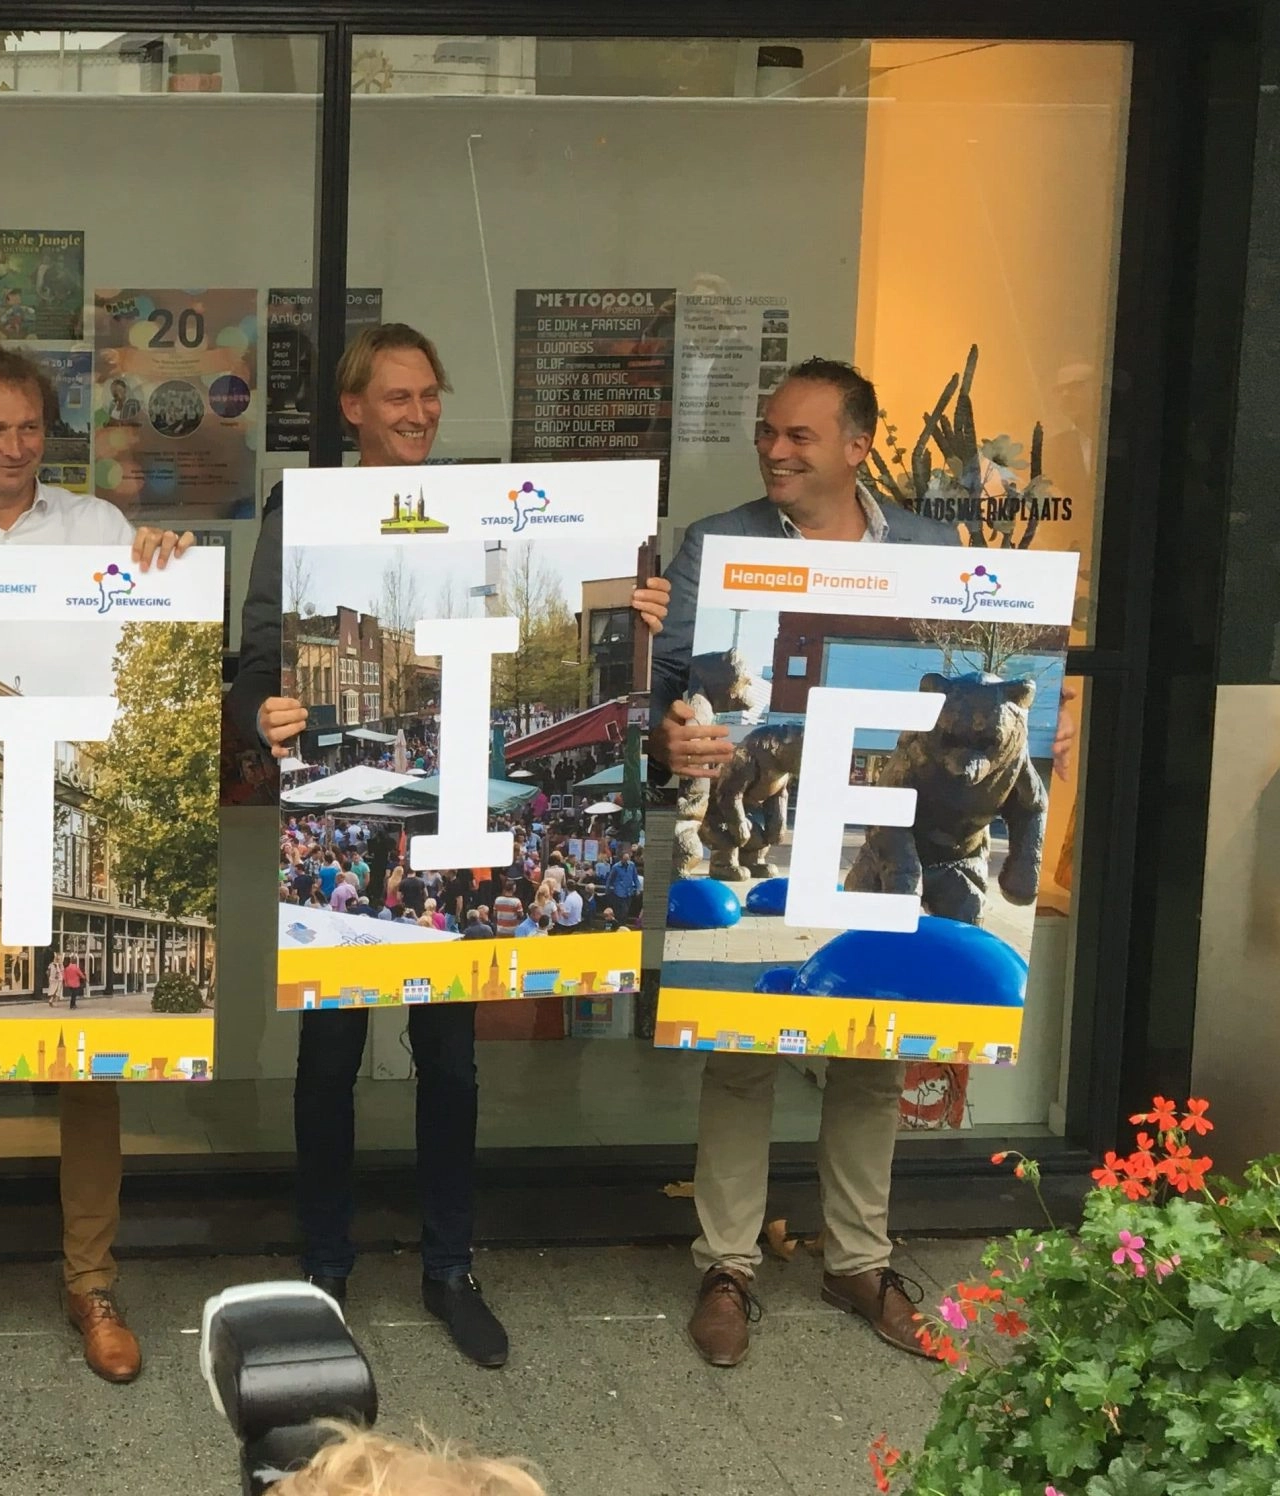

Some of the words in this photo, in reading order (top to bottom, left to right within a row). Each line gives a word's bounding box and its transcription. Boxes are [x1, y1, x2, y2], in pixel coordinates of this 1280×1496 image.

[3, 233, 15, 244] in
[19, 233, 34, 245] de
[38, 233, 81, 249] Jungle
[346, 295, 362, 305] De
[147, 308, 205, 349] 20
[537, 319, 552, 332] DE
[554, 319, 578, 331] DIJK
[591, 318, 641, 331] FRATSEN
[536, 341, 594, 354] LOUDNESS
[535, 373, 579, 386] WHISKY
[581, 373, 589, 385] &
[592, 372, 629, 385] MUSIC
[536, 389, 570, 401] TOOTS
[572, 389, 581, 400] &
[583, 388, 604, 400] THE
[606, 388, 662, 400] MAYTALS
[535, 405, 570, 417] DUTCH
[573, 405, 609, 417] QUEEN
[611, 404, 656, 416] TRIBUTE
[534, 420, 570, 432] CANDY
[572, 420, 616, 432] DULFER
[534, 436, 577, 448] ROBERT
[578, 435, 607, 447] CRAY
[609, 435, 639, 447] BAND
[481, 515, 514, 525] STADS
[530, 514, 585, 524] BEWEGING
[730, 569, 804, 589] Hengelo
[812, 572, 889, 590] Promotie
[65, 597, 100, 606] STADS
[115, 597, 171, 606] BEWEGING
[931, 596, 963, 606] STADS
[979, 598, 1035, 609] BEWEGING
[410, 616, 520, 871] I
[784, 686, 946, 933] E
